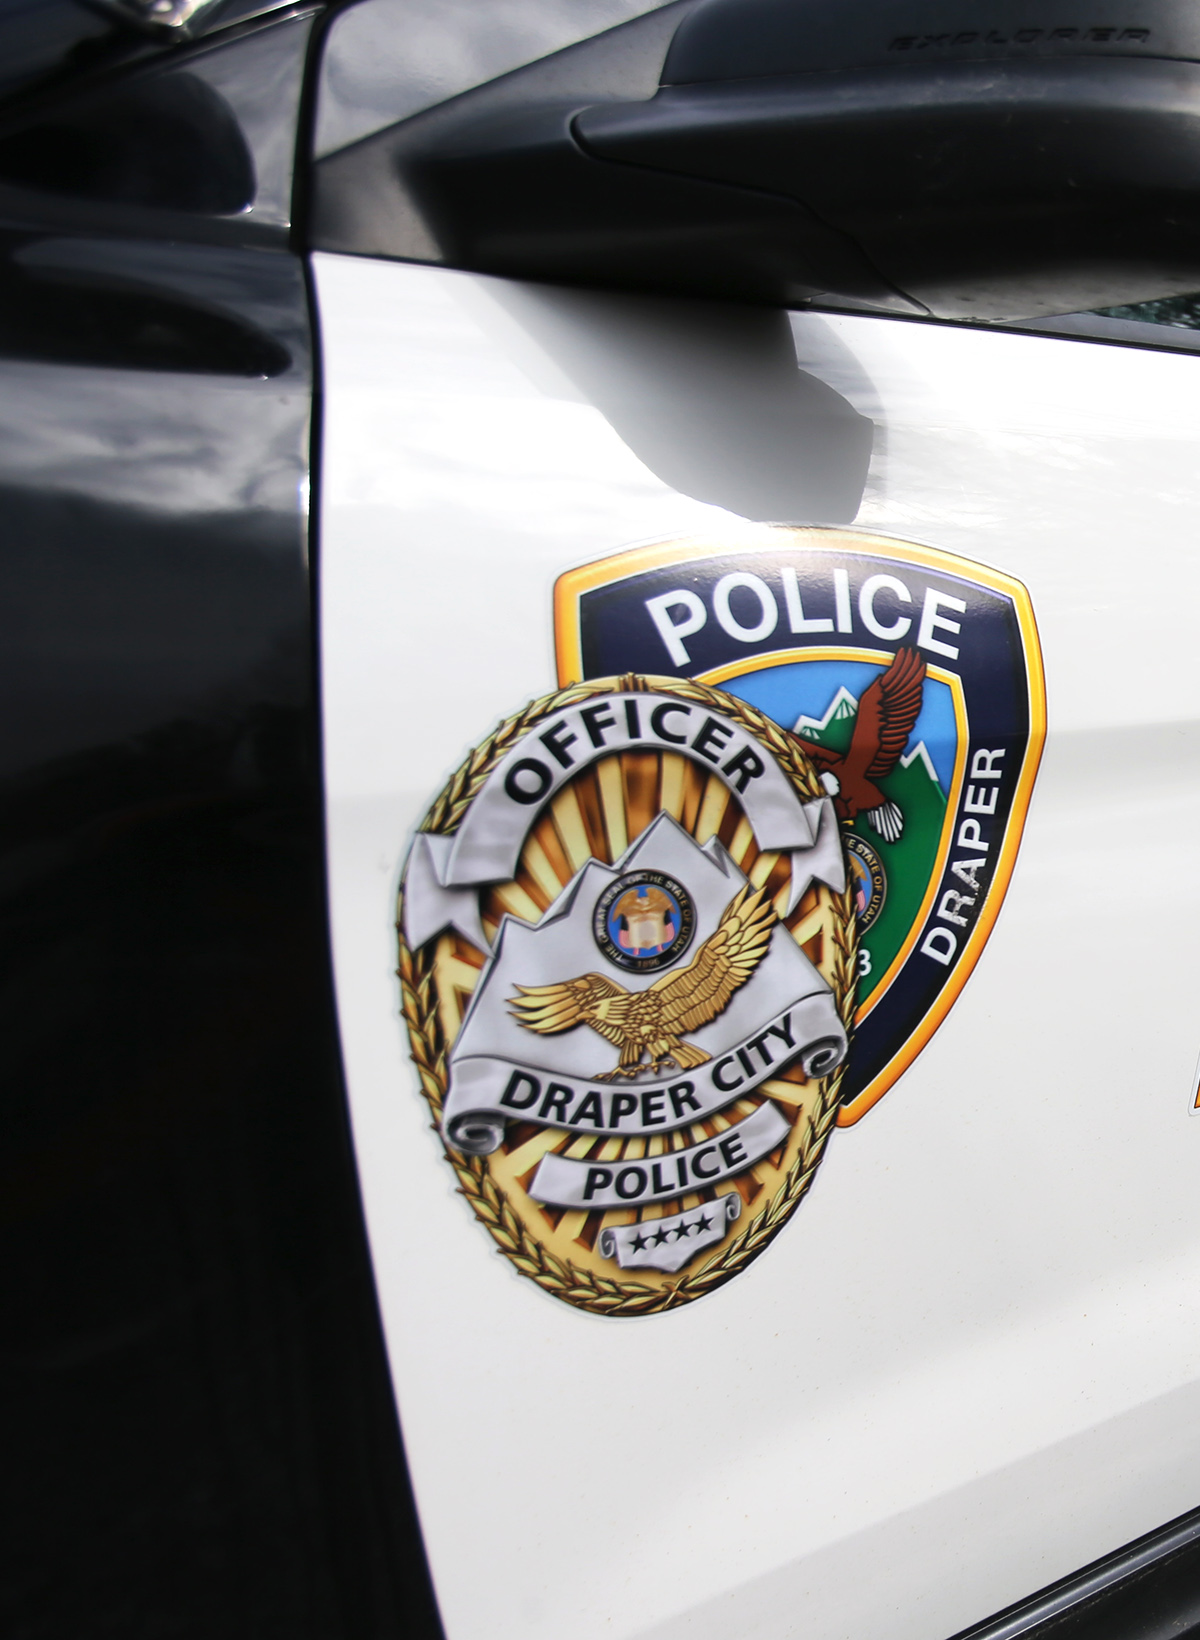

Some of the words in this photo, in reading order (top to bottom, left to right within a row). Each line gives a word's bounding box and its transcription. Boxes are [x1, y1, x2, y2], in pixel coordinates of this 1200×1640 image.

[887, 27, 1150, 51] EXPLORER
[645, 567, 967, 667] POLICE
[503, 699, 766, 805] OFFICER
[856, 844, 880, 873] STATE
[920, 748, 1006, 966] DRAPER
[603, 882, 625, 906] SEAL
[664, 880, 688, 905] STATE
[874, 876, 883, 891] OF
[682, 909, 691, 922] OF
[861, 895, 881, 924] UTAH
[604, 943, 624, 961] THE
[671, 926, 691, 952] UTAH
[501, 1070, 702, 1129] DRAPER
[712, 1012, 798, 1092] CITY
[582, 1134, 748, 1200] POLICE
